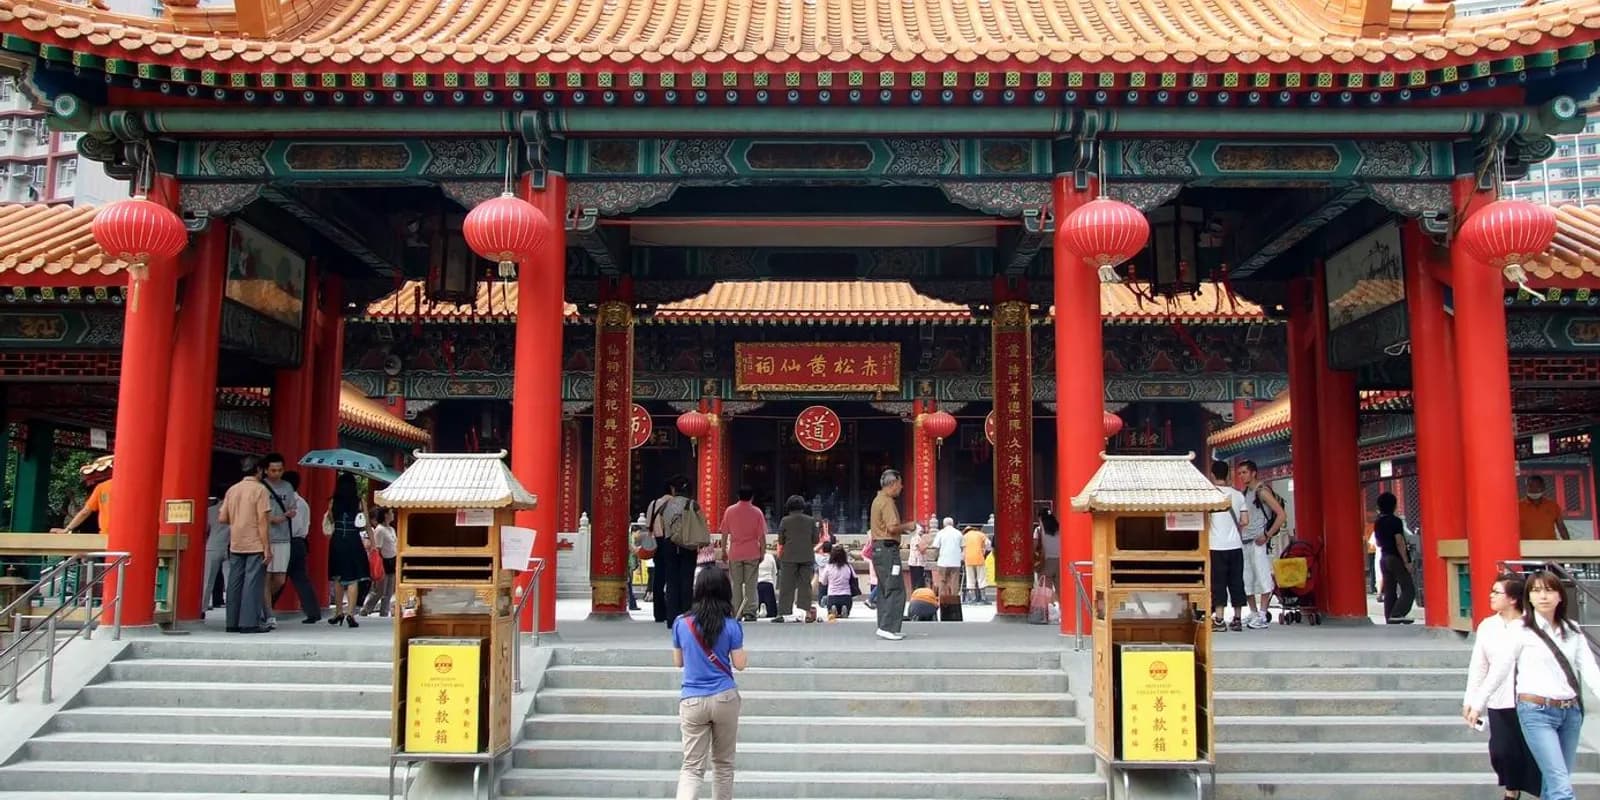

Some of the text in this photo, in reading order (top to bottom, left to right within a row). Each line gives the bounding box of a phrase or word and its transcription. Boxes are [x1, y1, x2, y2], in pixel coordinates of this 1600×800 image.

[803, 412, 832, 444] 道
[435, 689, 450, 744] 善款箱
[1153, 696, 1168, 752] 善款箱
